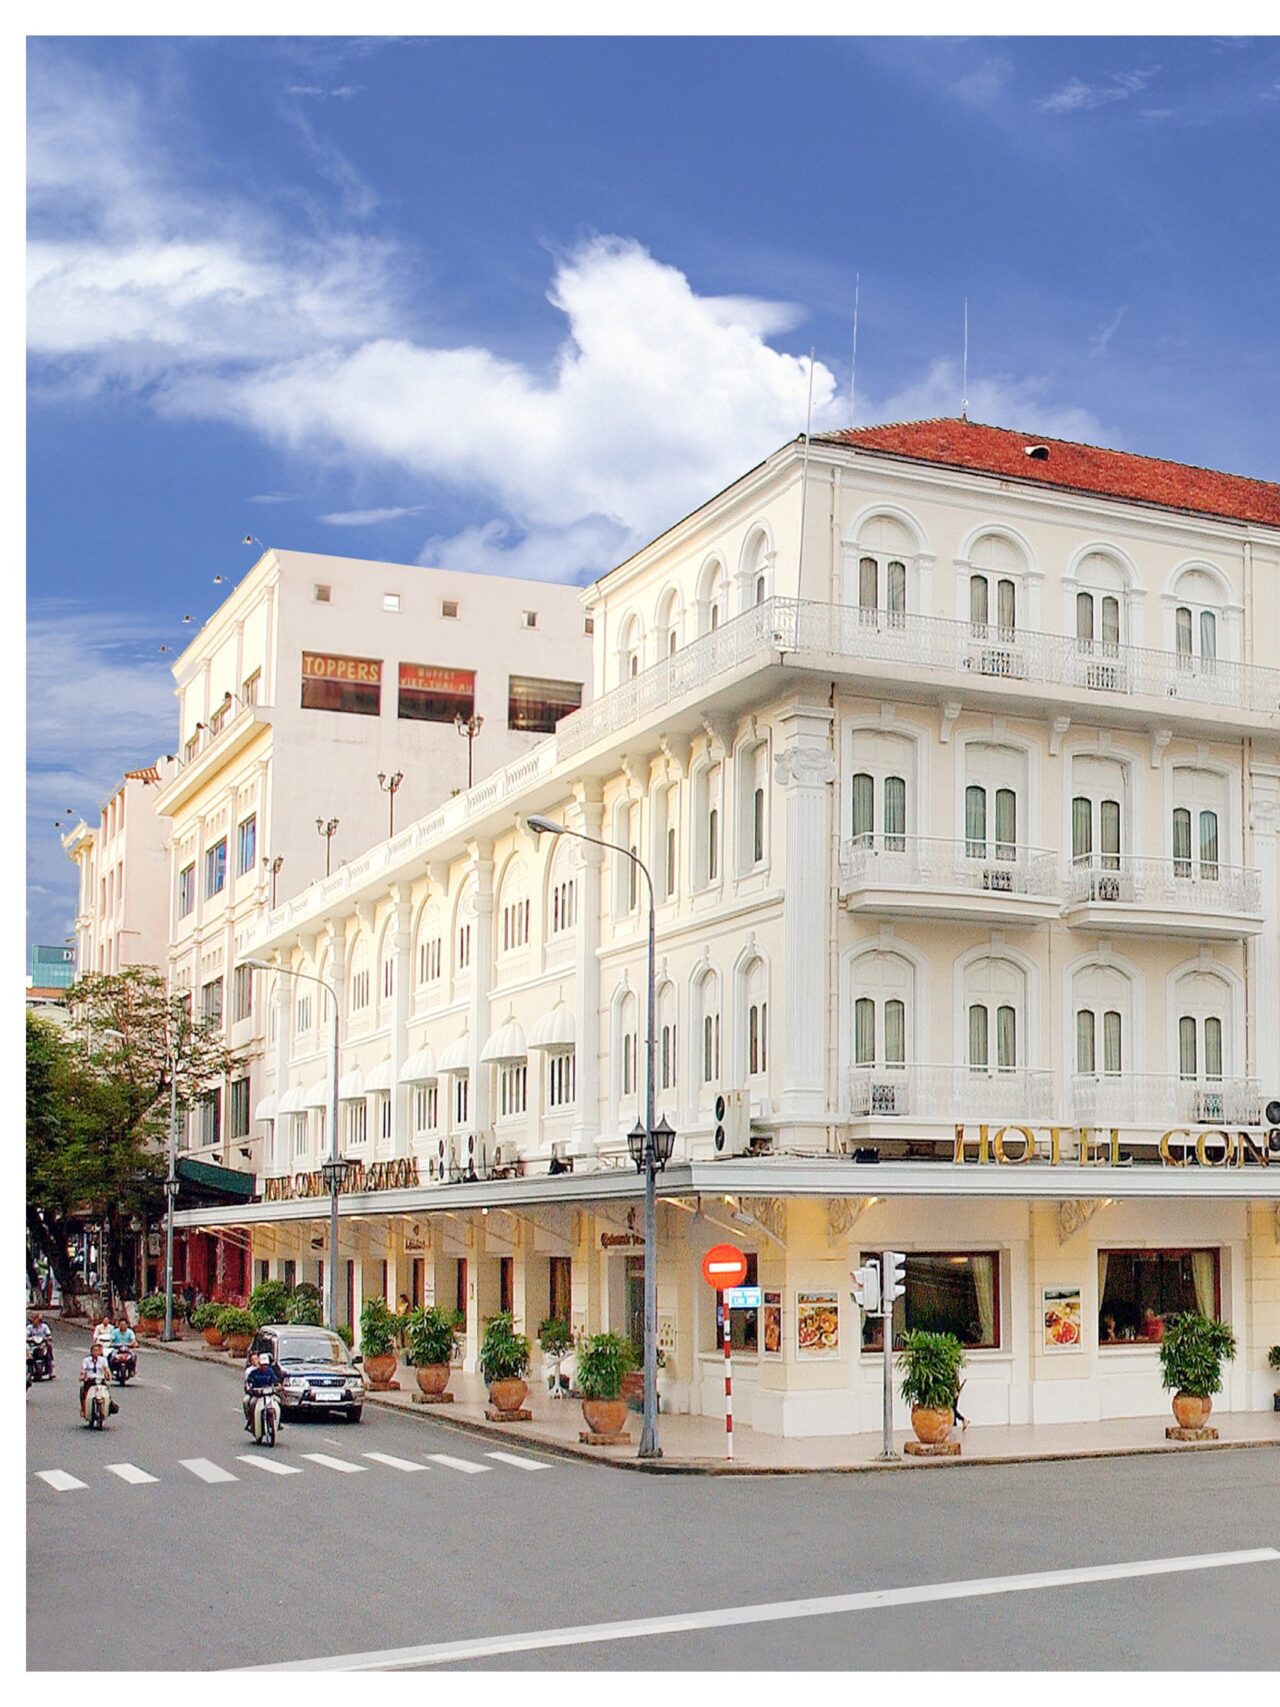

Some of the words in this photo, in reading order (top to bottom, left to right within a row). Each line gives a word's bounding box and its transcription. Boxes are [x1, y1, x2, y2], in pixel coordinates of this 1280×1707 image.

[304, 656, 378, 681] TOPPERS
[417, 667, 455, 680] BUFFET
[954, 1123, 1135, 1168] HOTEL
